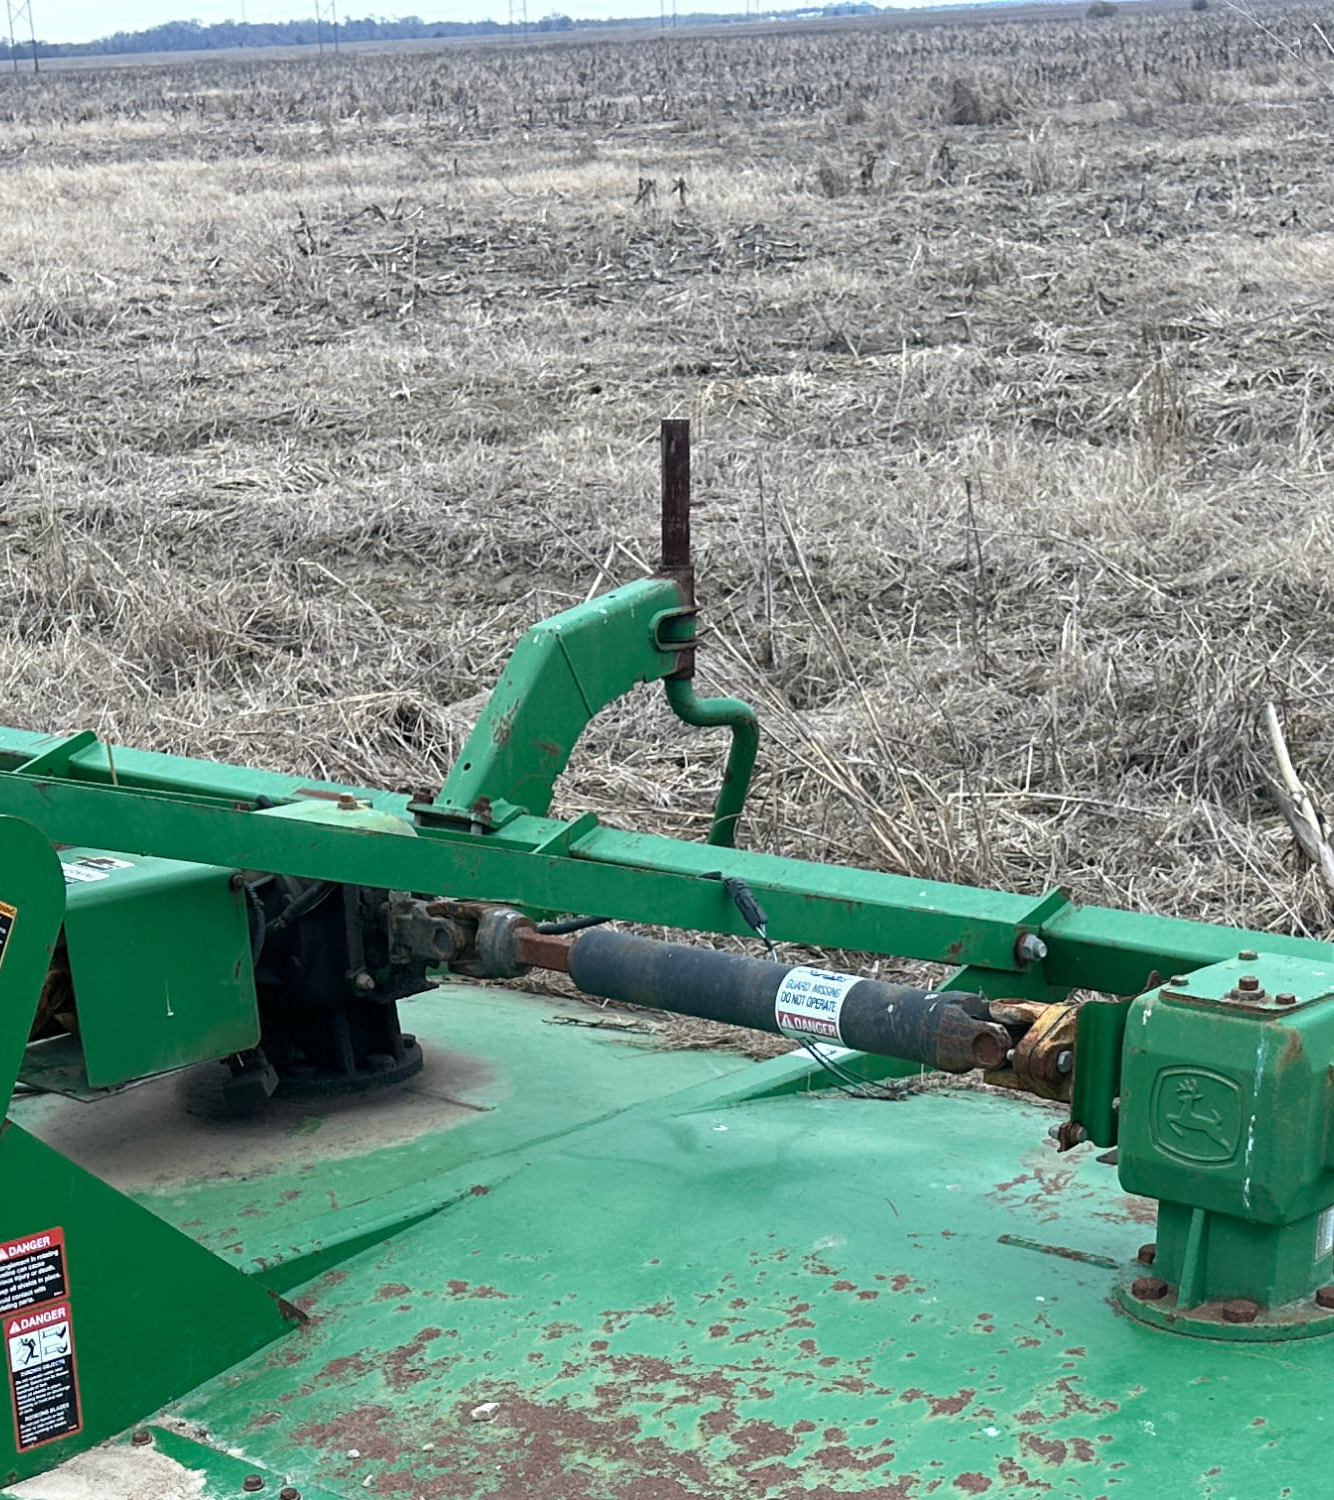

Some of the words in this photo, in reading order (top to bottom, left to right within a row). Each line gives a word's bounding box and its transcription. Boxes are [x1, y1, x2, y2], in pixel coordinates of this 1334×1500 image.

[786, 978, 811, 992] GUARD
[812, 983, 842, 998] MISSING
[780, 991, 791, 1003] DO
[792, 993, 806, 1007] NOT
[806, 995, 838, 1013] OPERATE
[793, 1017, 838, 1037] DANGER
[8, 1236, 51, 1257] DANGER
[20, 1307, 66, 1330] DANGER
